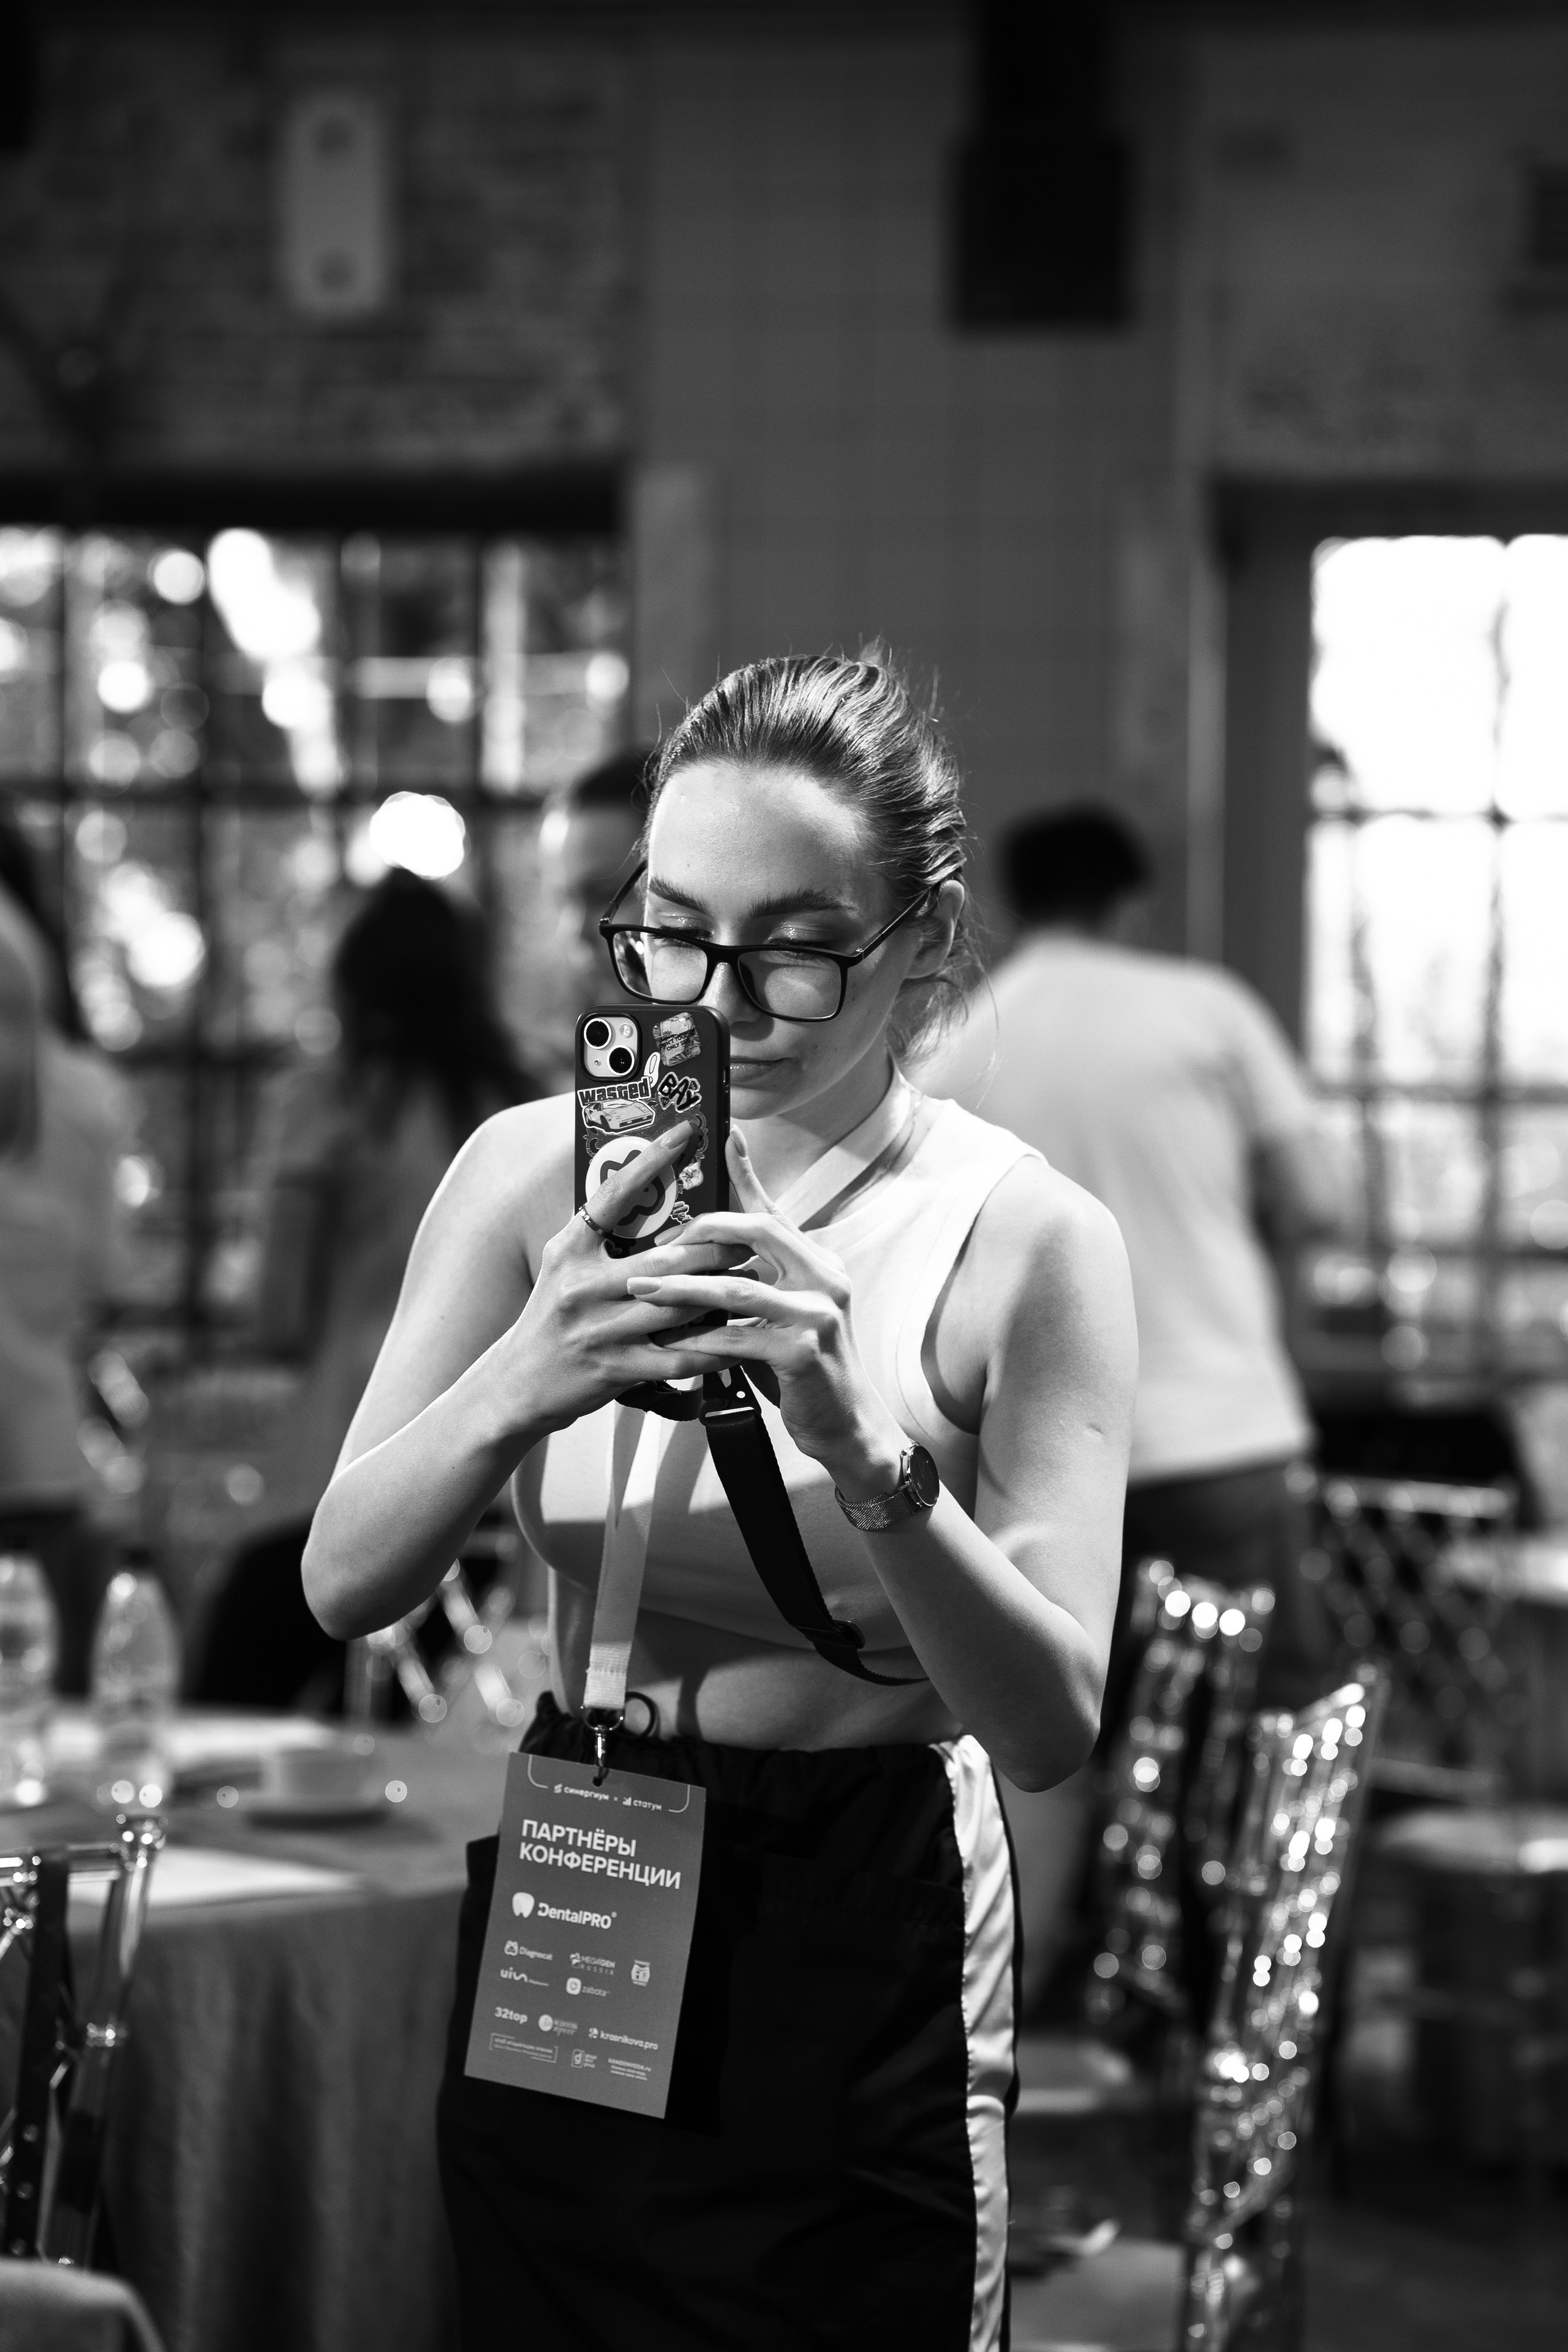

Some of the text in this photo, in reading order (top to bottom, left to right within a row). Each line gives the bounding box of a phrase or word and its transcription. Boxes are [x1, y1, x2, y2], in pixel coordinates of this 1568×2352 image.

[666, 1042, 679, 1051] ONLY
[674, 1030, 693, 1041] TOUC
[658, 1074, 700, 1112] BAY
[564, 1786, 662, 1811] синергиум статум
[522, 1819, 636, 1856] ПАРТНЁРЫ
[519, 1842, 682, 1889] КОНФЕРЕНЦИИ
[494, 2007, 527, 2024] 32top
[600, 2030, 658, 2051] krasnikova.pro
